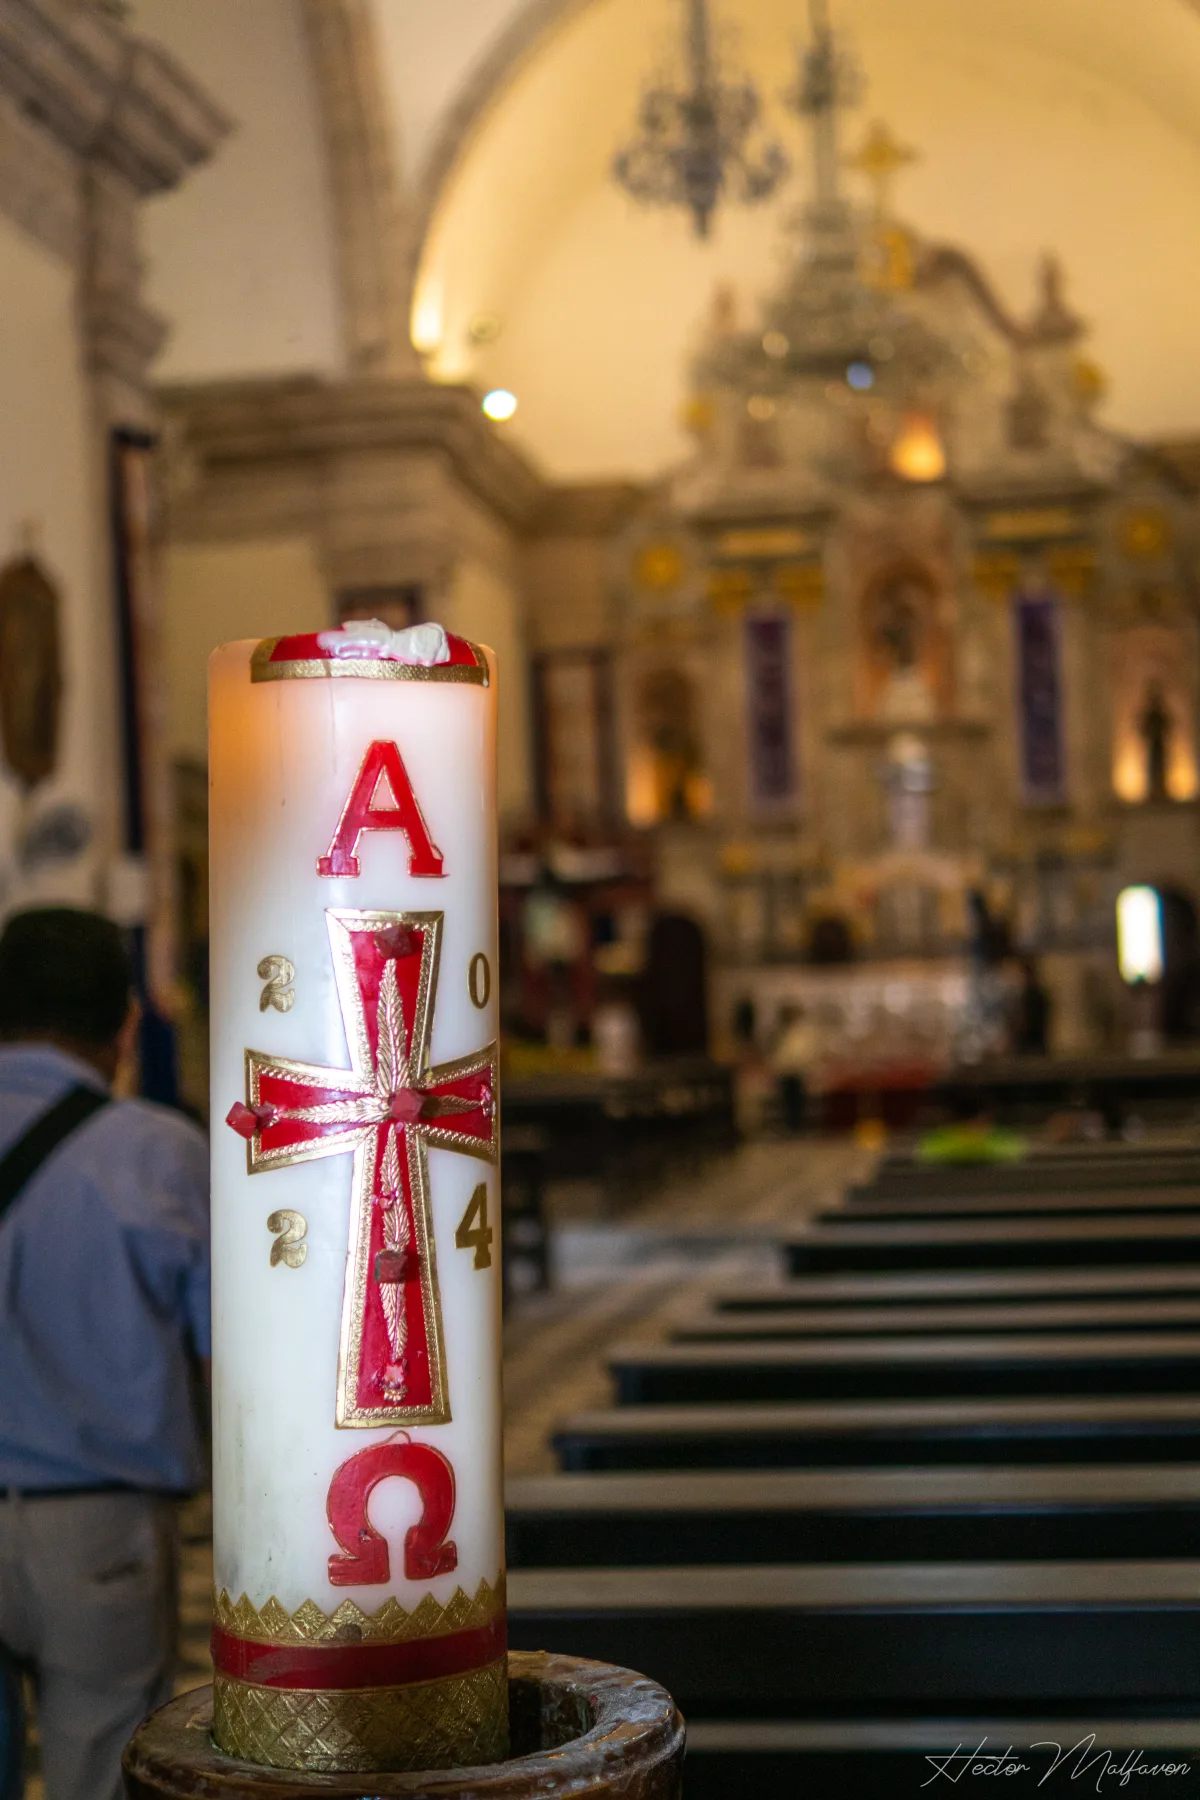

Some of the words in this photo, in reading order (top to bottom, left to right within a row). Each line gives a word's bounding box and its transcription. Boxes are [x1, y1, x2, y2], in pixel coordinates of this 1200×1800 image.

[316, 740, 449, 878] A
[257, 954, 295, 1013] 2
[467, 952, 491, 1009] 0
[266, 1208, 308, 1269] 2
[454, 1182, 493, 1271] 4
[326, 1432, 458, 1586] Ω
